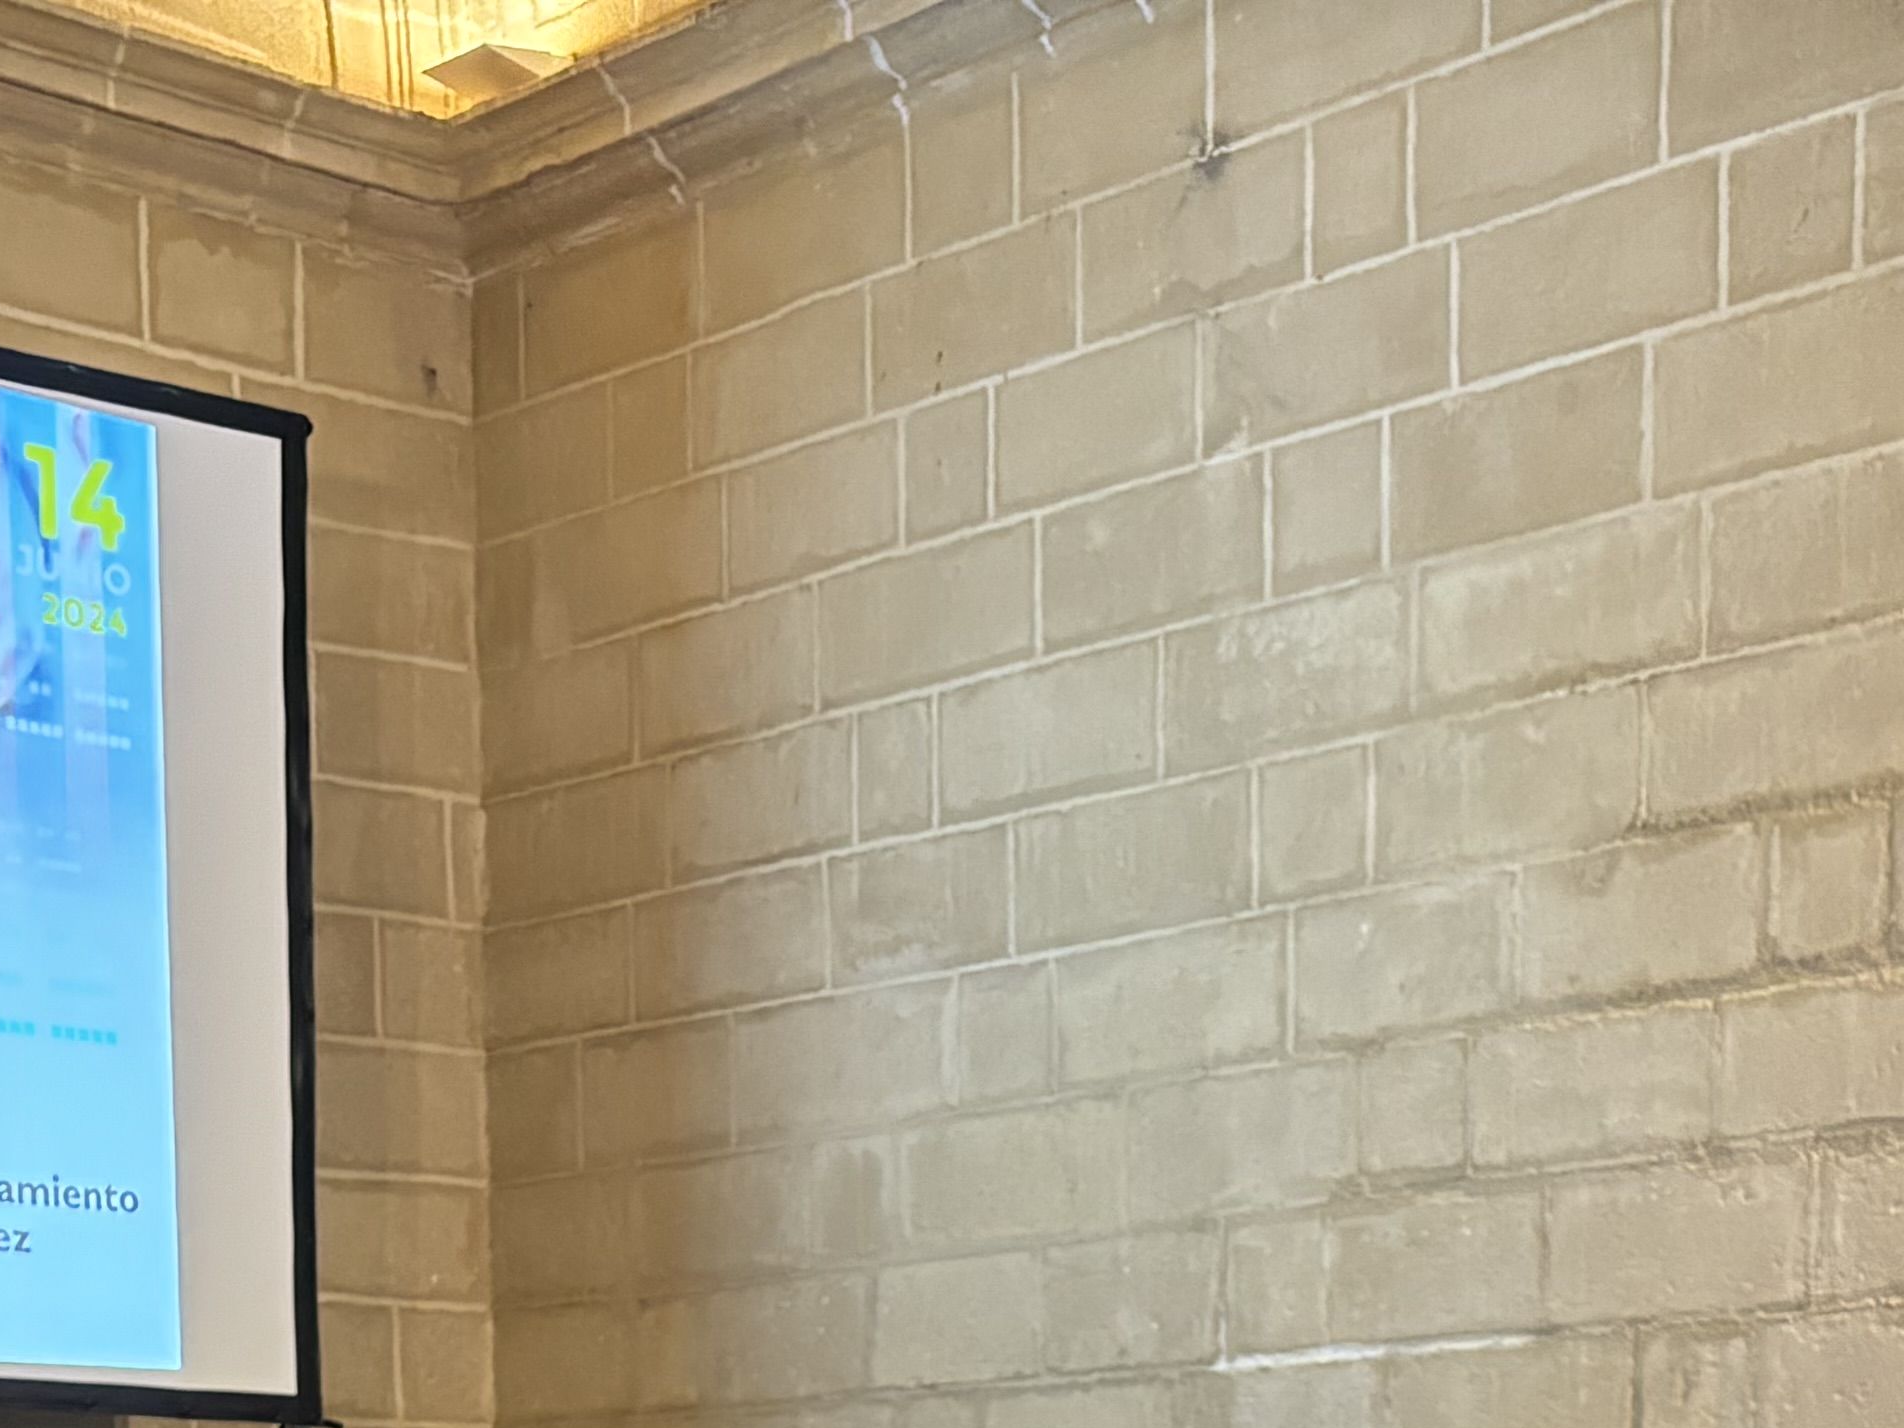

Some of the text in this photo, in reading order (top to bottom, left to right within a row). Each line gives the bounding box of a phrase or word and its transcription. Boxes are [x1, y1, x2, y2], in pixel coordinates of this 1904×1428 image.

[24, 443, 125, 551] 14
[16, 544, 131, 595] JUO
[41, 592, 128, 638] 2024
